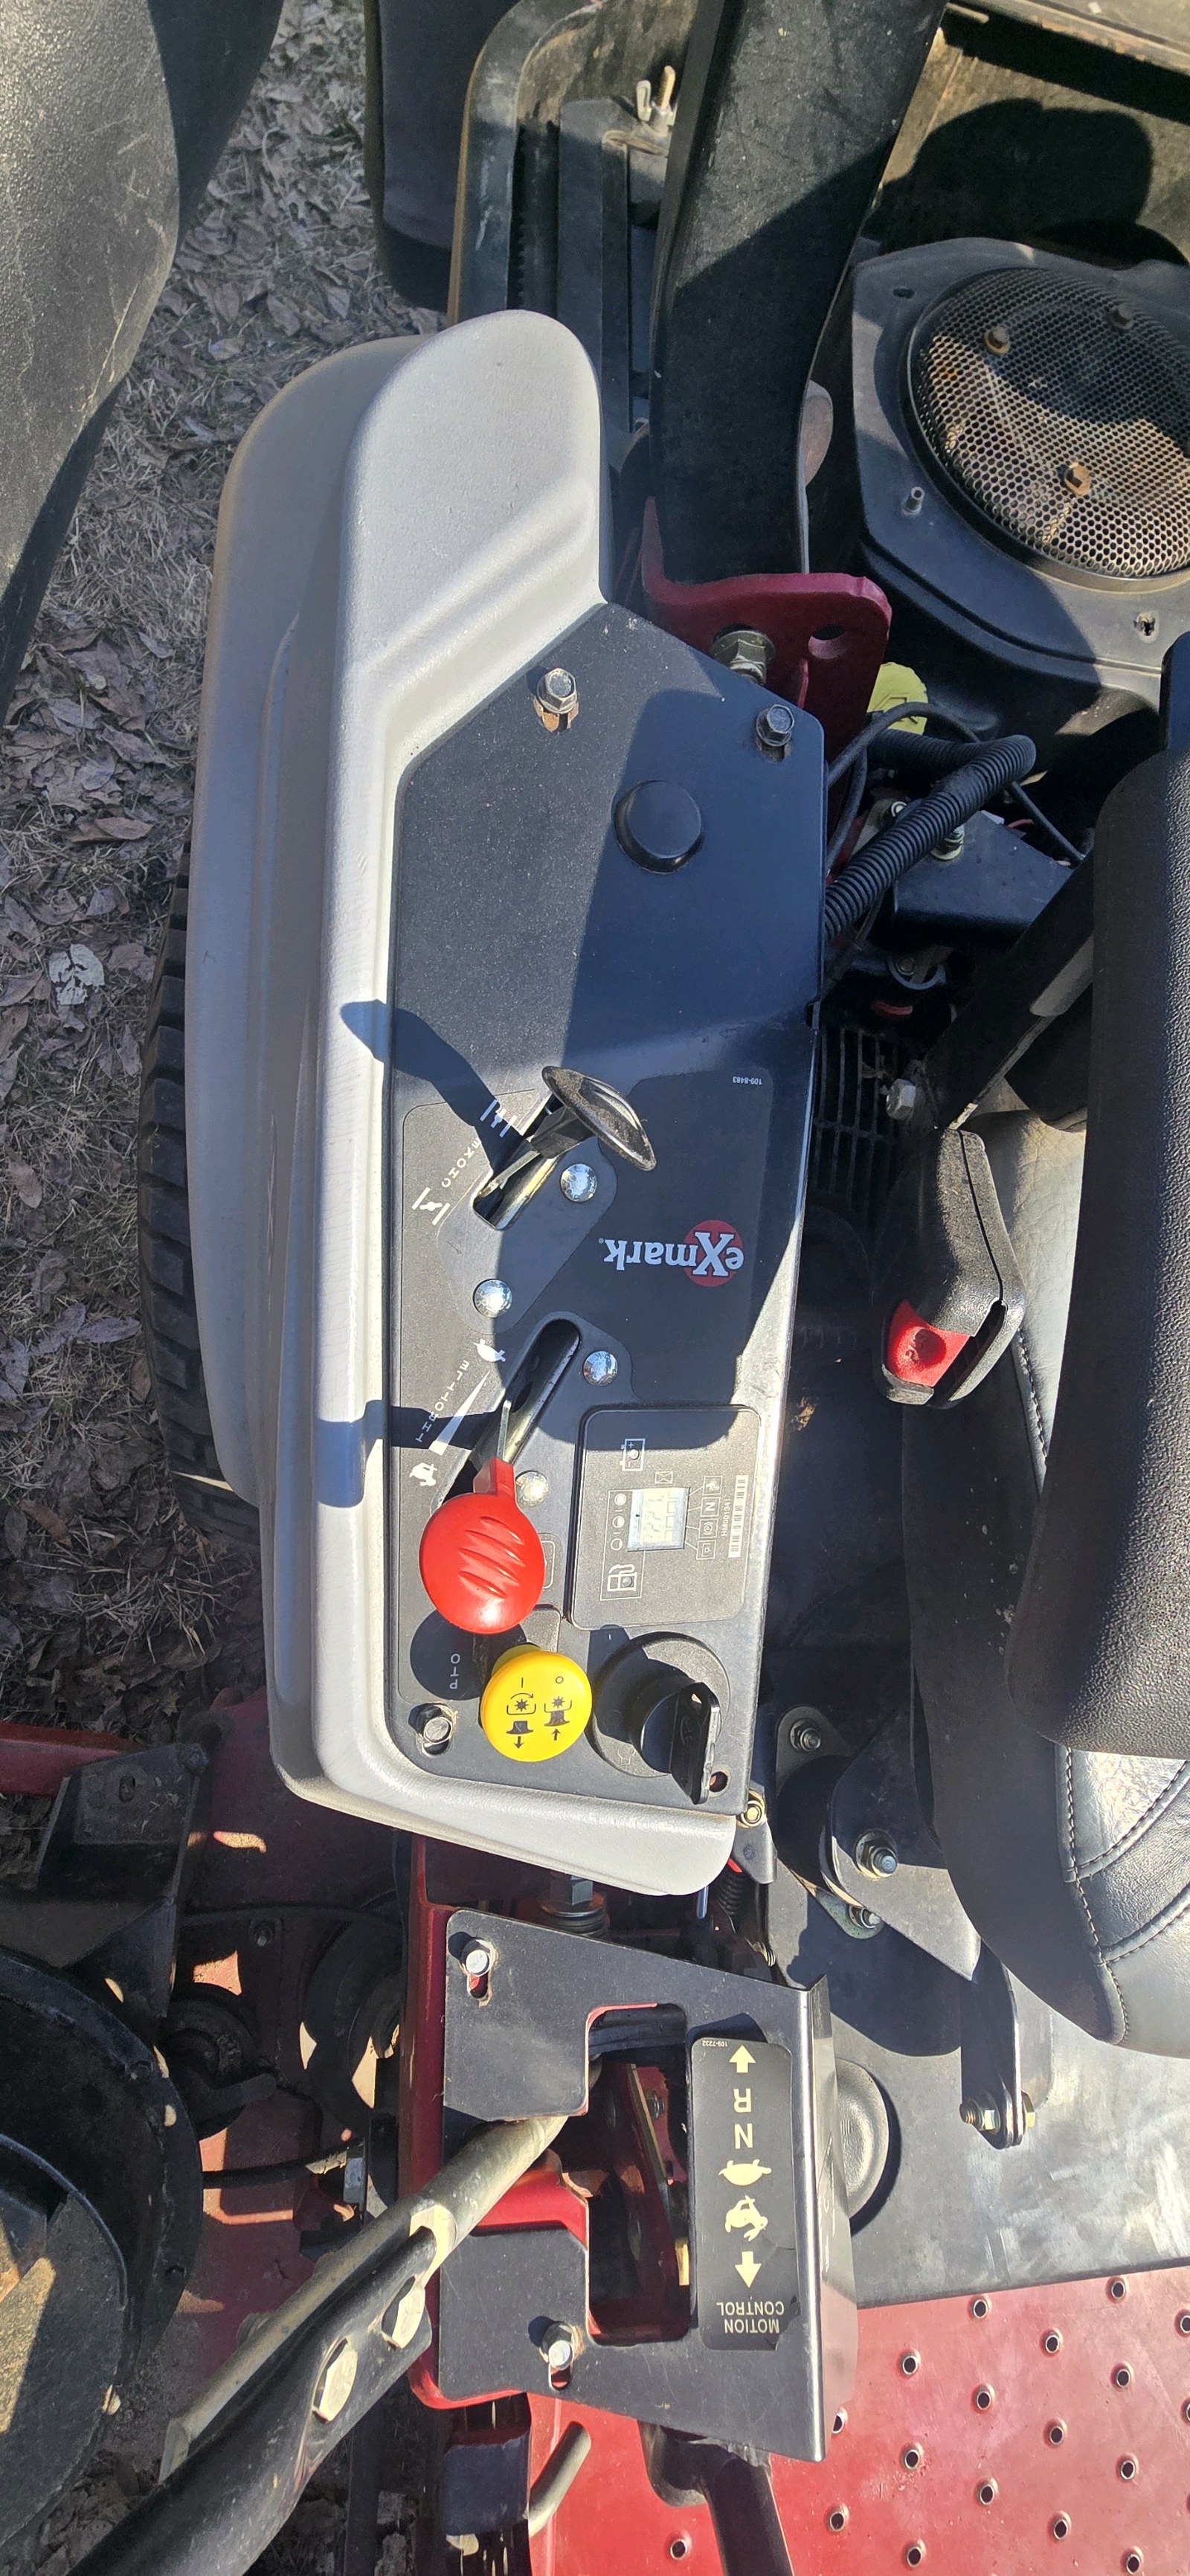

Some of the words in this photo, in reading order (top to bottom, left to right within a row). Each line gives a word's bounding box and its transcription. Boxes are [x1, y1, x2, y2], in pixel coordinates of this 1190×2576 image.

[732, 1076, 762, 1085] 109-8483
[441, 1137, 482, 1188] CHOKE
[603, 1232, 744, 1276] eXmark
[415, 1359, 470, 1443] THROTTLE
[449, 1653, 461, 1690] PTO
[733, 2088, 752, 2113] R
[734, 2123, 754, 2150] N
[716, 2301, 785, 2316] CONTROL
[724, 2319, 780, 2334] MOTION
